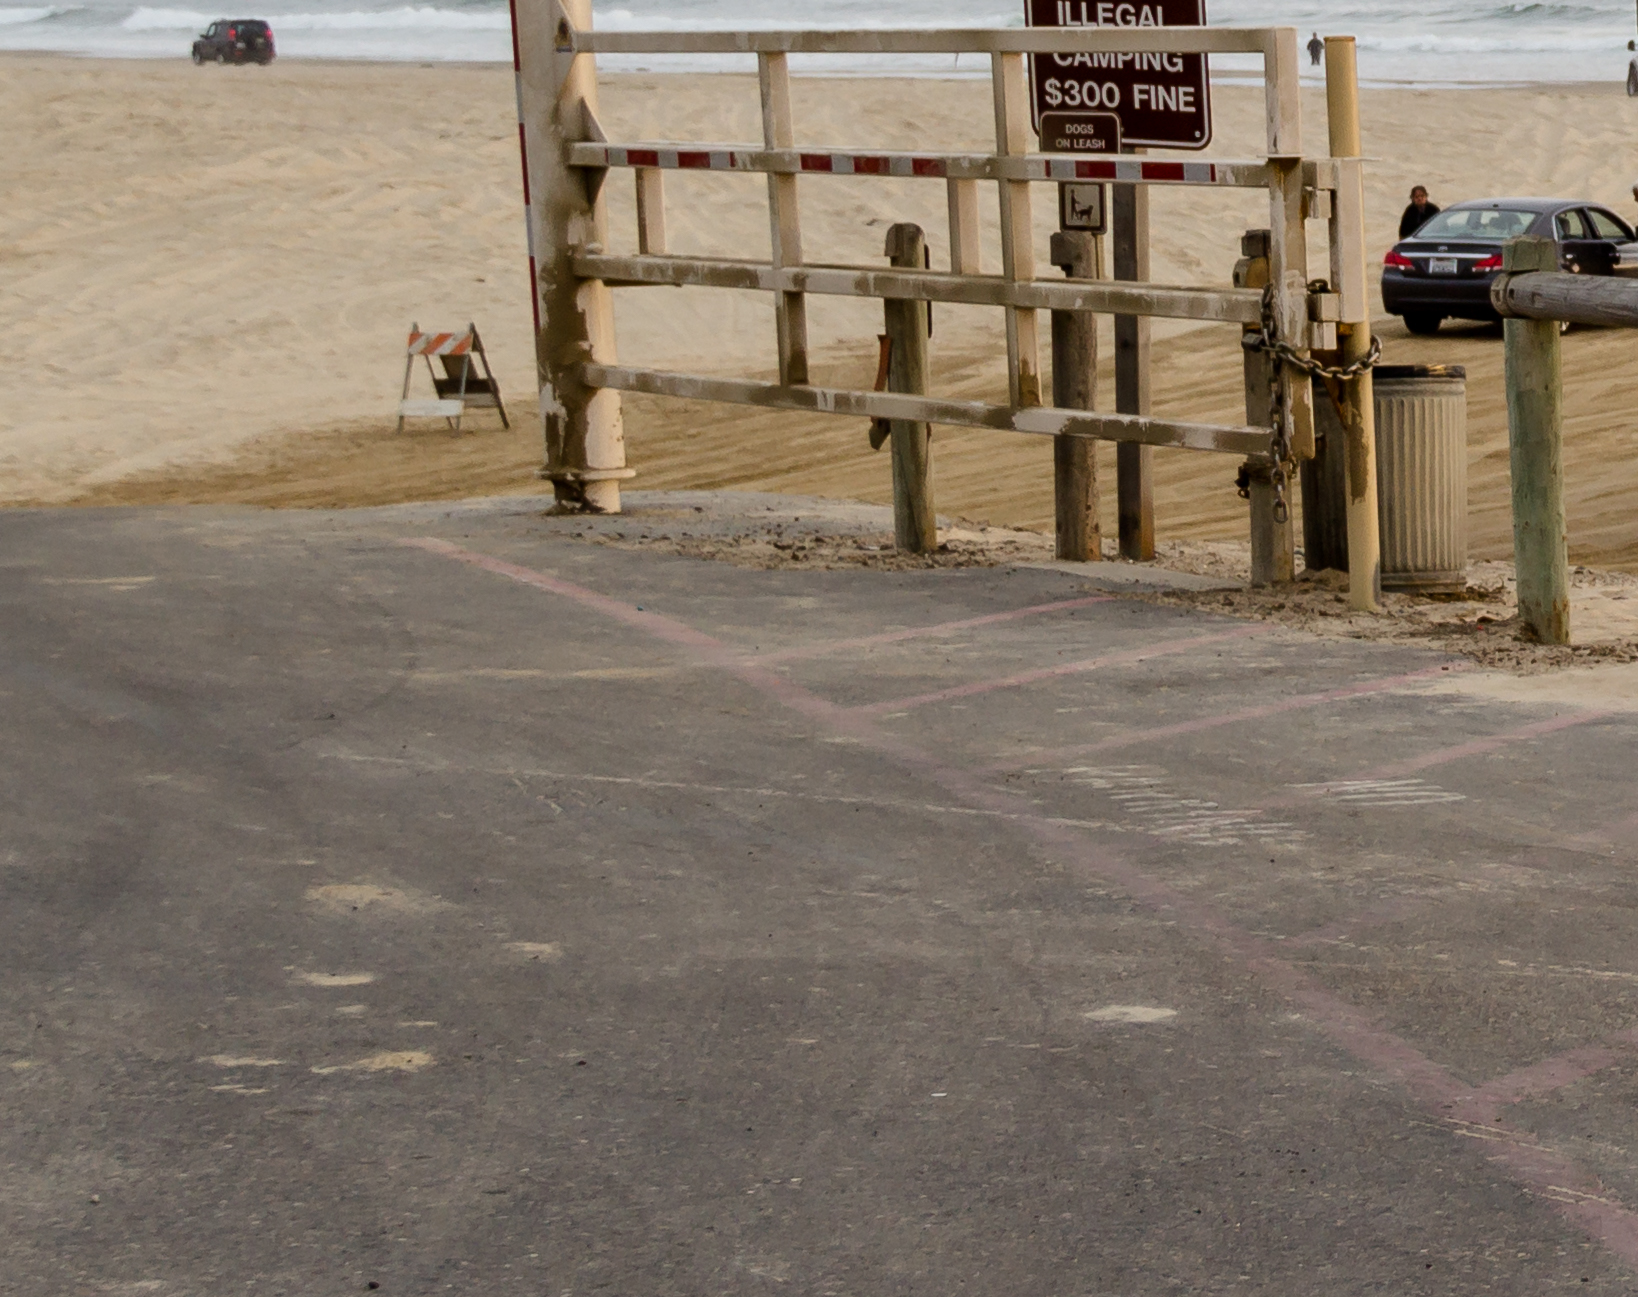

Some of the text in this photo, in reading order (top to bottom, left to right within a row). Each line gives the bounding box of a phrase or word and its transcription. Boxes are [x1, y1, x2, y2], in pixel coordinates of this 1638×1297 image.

[1057, 0, 1163, 26] ILLEGAL
[1045, 77, 1196, 112] $300 FINE
[1066, 125, 1093, 134] DOGS
[1056, 139, 1105, 148] ON LEASH
